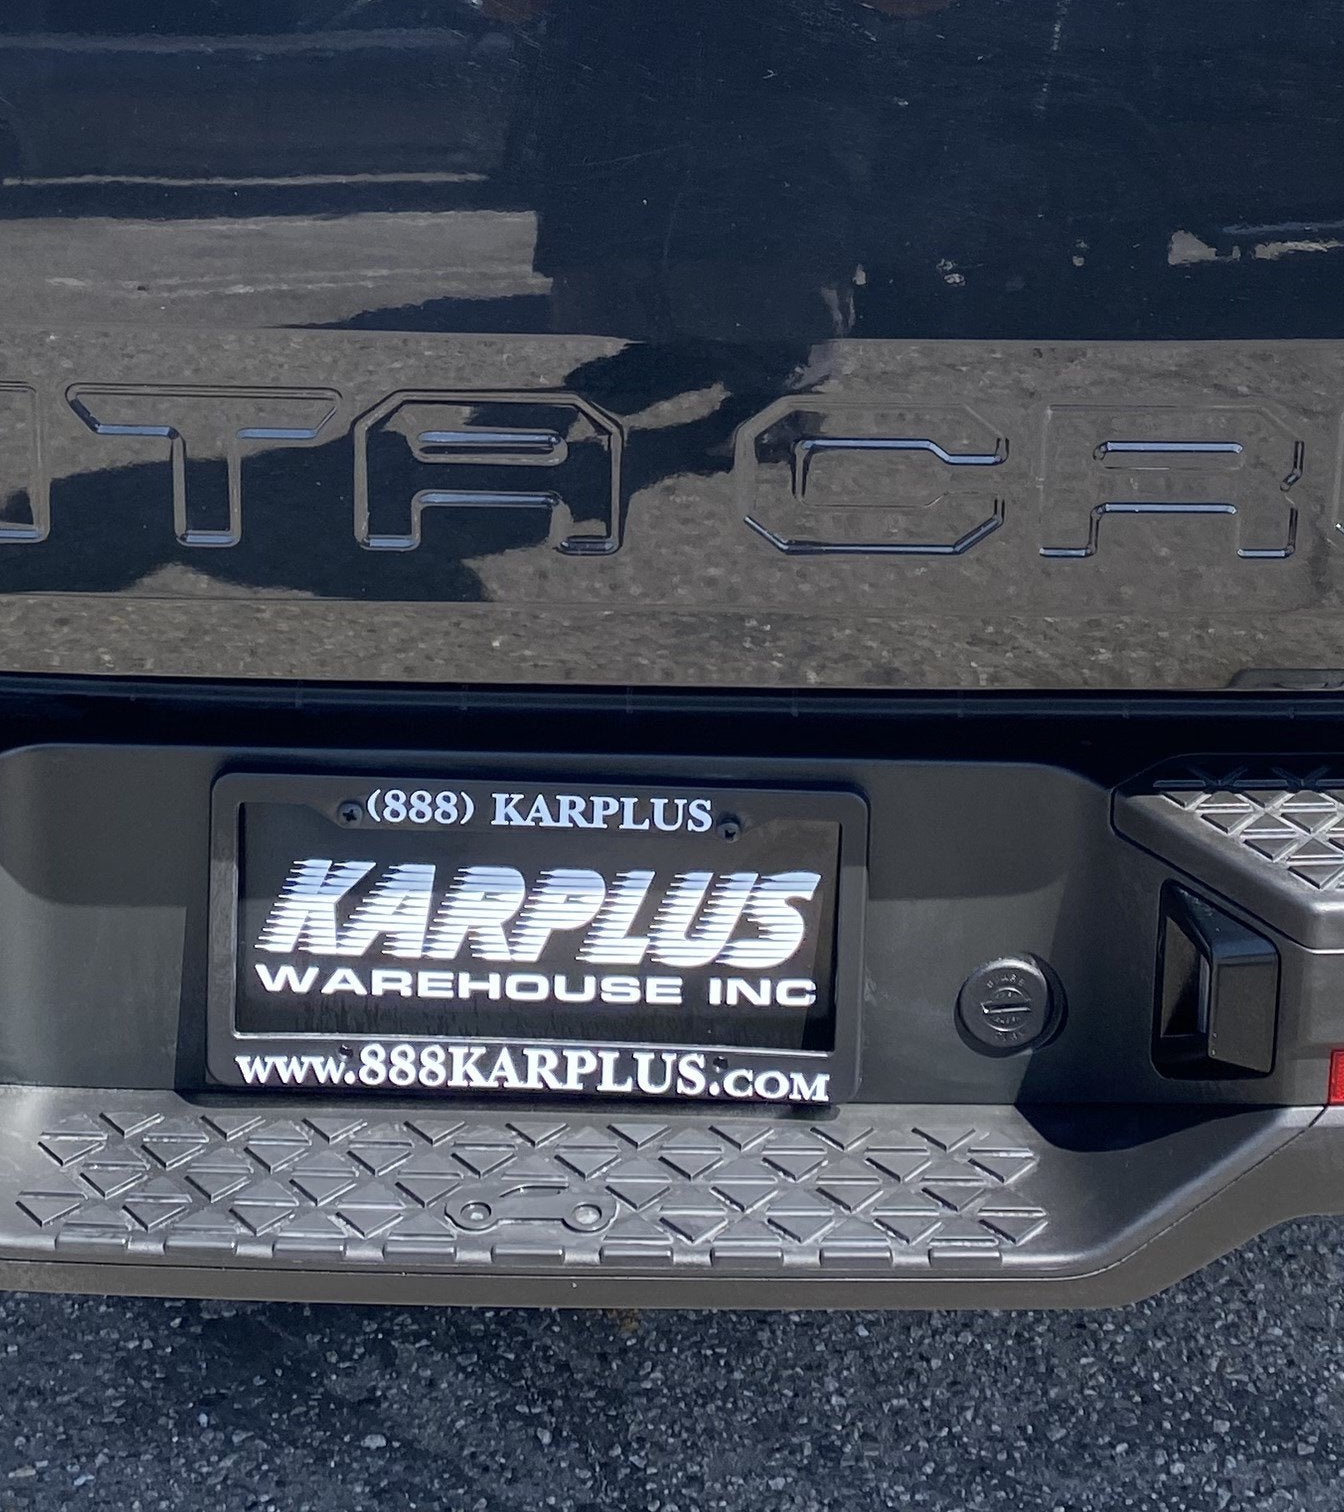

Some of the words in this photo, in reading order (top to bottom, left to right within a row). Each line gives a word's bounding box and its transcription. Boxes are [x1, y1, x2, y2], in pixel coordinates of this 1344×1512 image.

[366, 789, 475, 825] (888)
[491, 793, 714, 832] KARPLUS
[254, 858, 823, 968] KARPLUS
[255, 964, 684, 1005] WAREHOUSE
[708, 978, 818, 1007] INC
